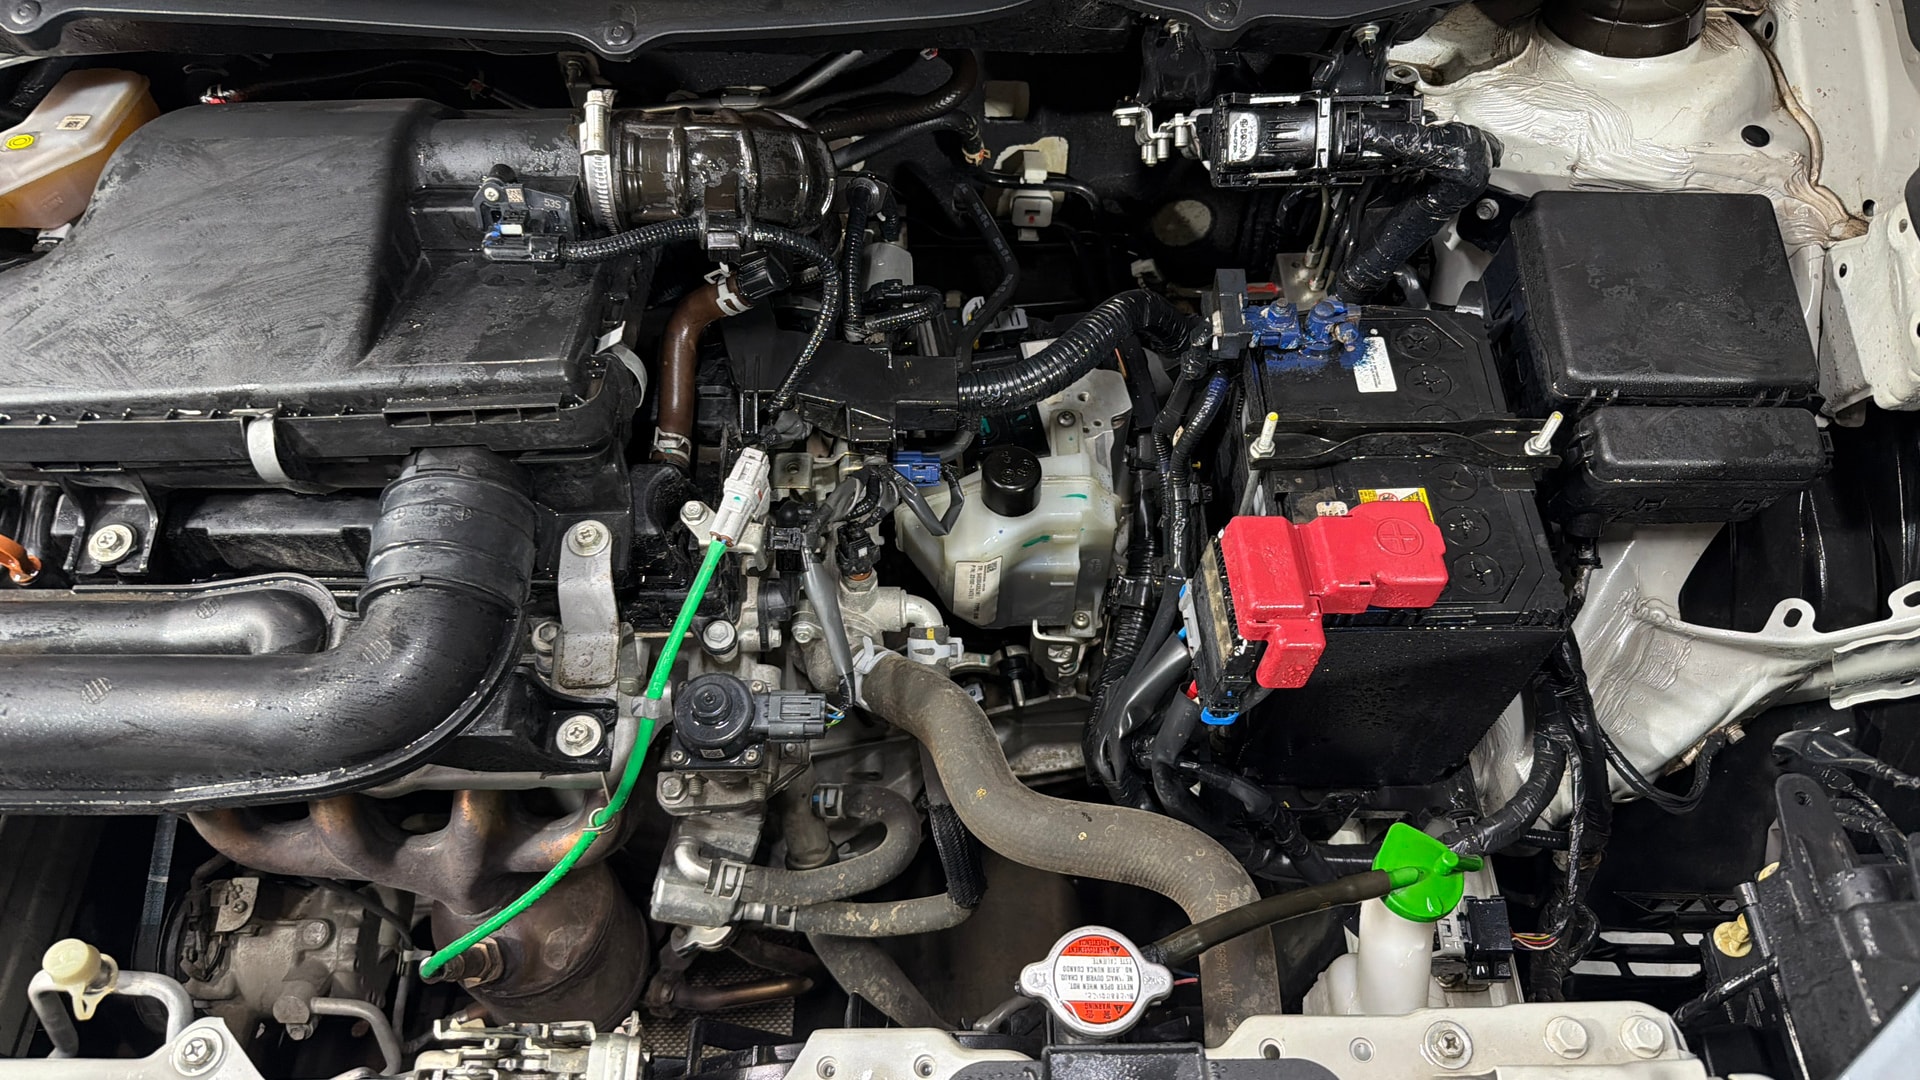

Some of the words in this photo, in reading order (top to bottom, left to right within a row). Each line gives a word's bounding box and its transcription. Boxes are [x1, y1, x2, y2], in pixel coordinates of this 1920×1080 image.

[544, 198, 561, 209] 53S
[1078, 939, 1110, 947] ADVERTENCIA
[1068, 946, 1110, 955] AVERTISSEMENT
[1062, 965, 1084, 973] CUANDO
[1085, 974, 1104, 982] OUVRIR
